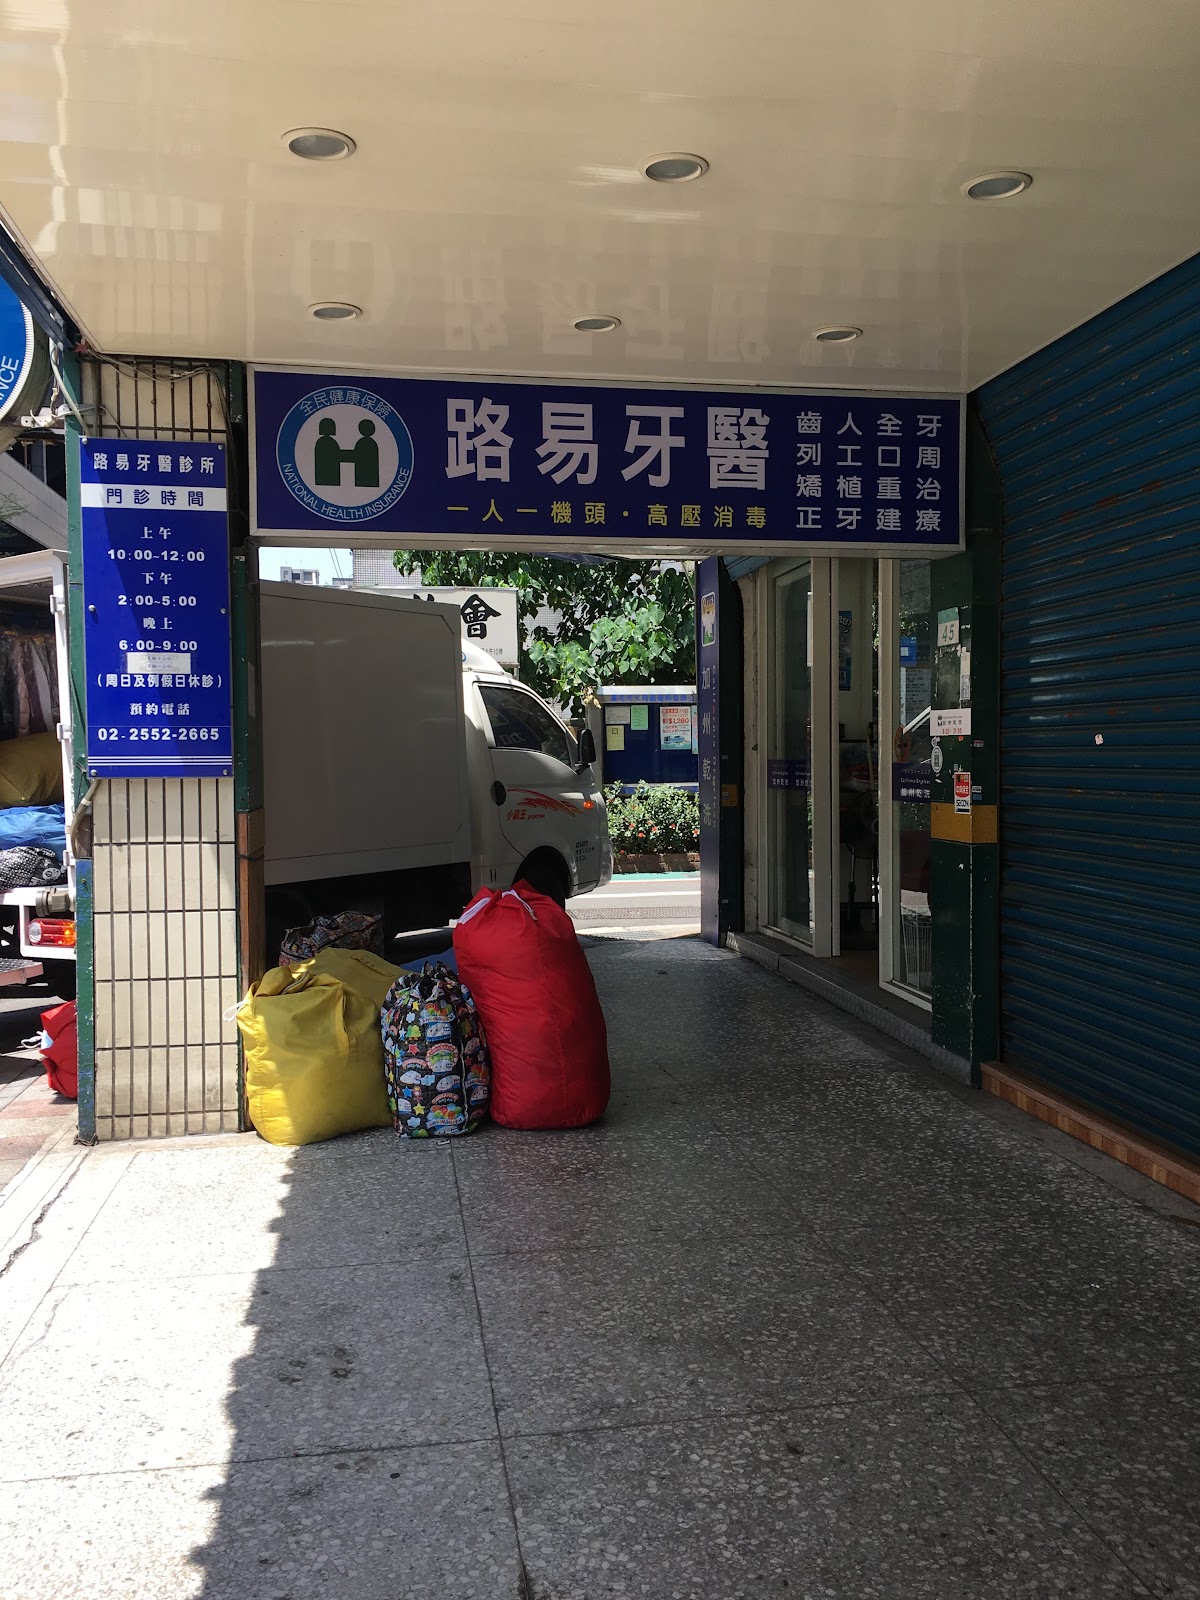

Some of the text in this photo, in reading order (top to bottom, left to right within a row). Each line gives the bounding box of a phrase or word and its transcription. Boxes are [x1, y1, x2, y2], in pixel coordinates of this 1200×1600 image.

[299, 389, 391, 421] 全民健康保險
[444, 396, 770, 491] 路易牙醫
[93, 452, 215, 475] 路易牙醫診所
[796, 411, 823, 530] 齒列矯正
[836, 412, 863, 530] 人工植牙
[876, 413, 903, 531] 全口重建
[915, 414, 943, 532] 牙周治療
[106, 488, 204, 507] 門診時間
[282, 462, 411, 519] NATIONAL HEALTH INSURANCE
[140, 526, 172, 540] 上午
[107, 549, 206, 562] 10:00~12:00
[141, 572, 173, 585] 下午
[117, 595, 197, 607] 2:00~5:00
[142, 617, 174, 630] 晚上
[942, 623, 955, 642] 45
[118, 640, 198, 651] 6:00~9:00
[129, 702, 190, 716] 預約電話
[97, 727, 220, 741] 02-2552-2665
[701, 666, 712, 826] 加州乾洗
